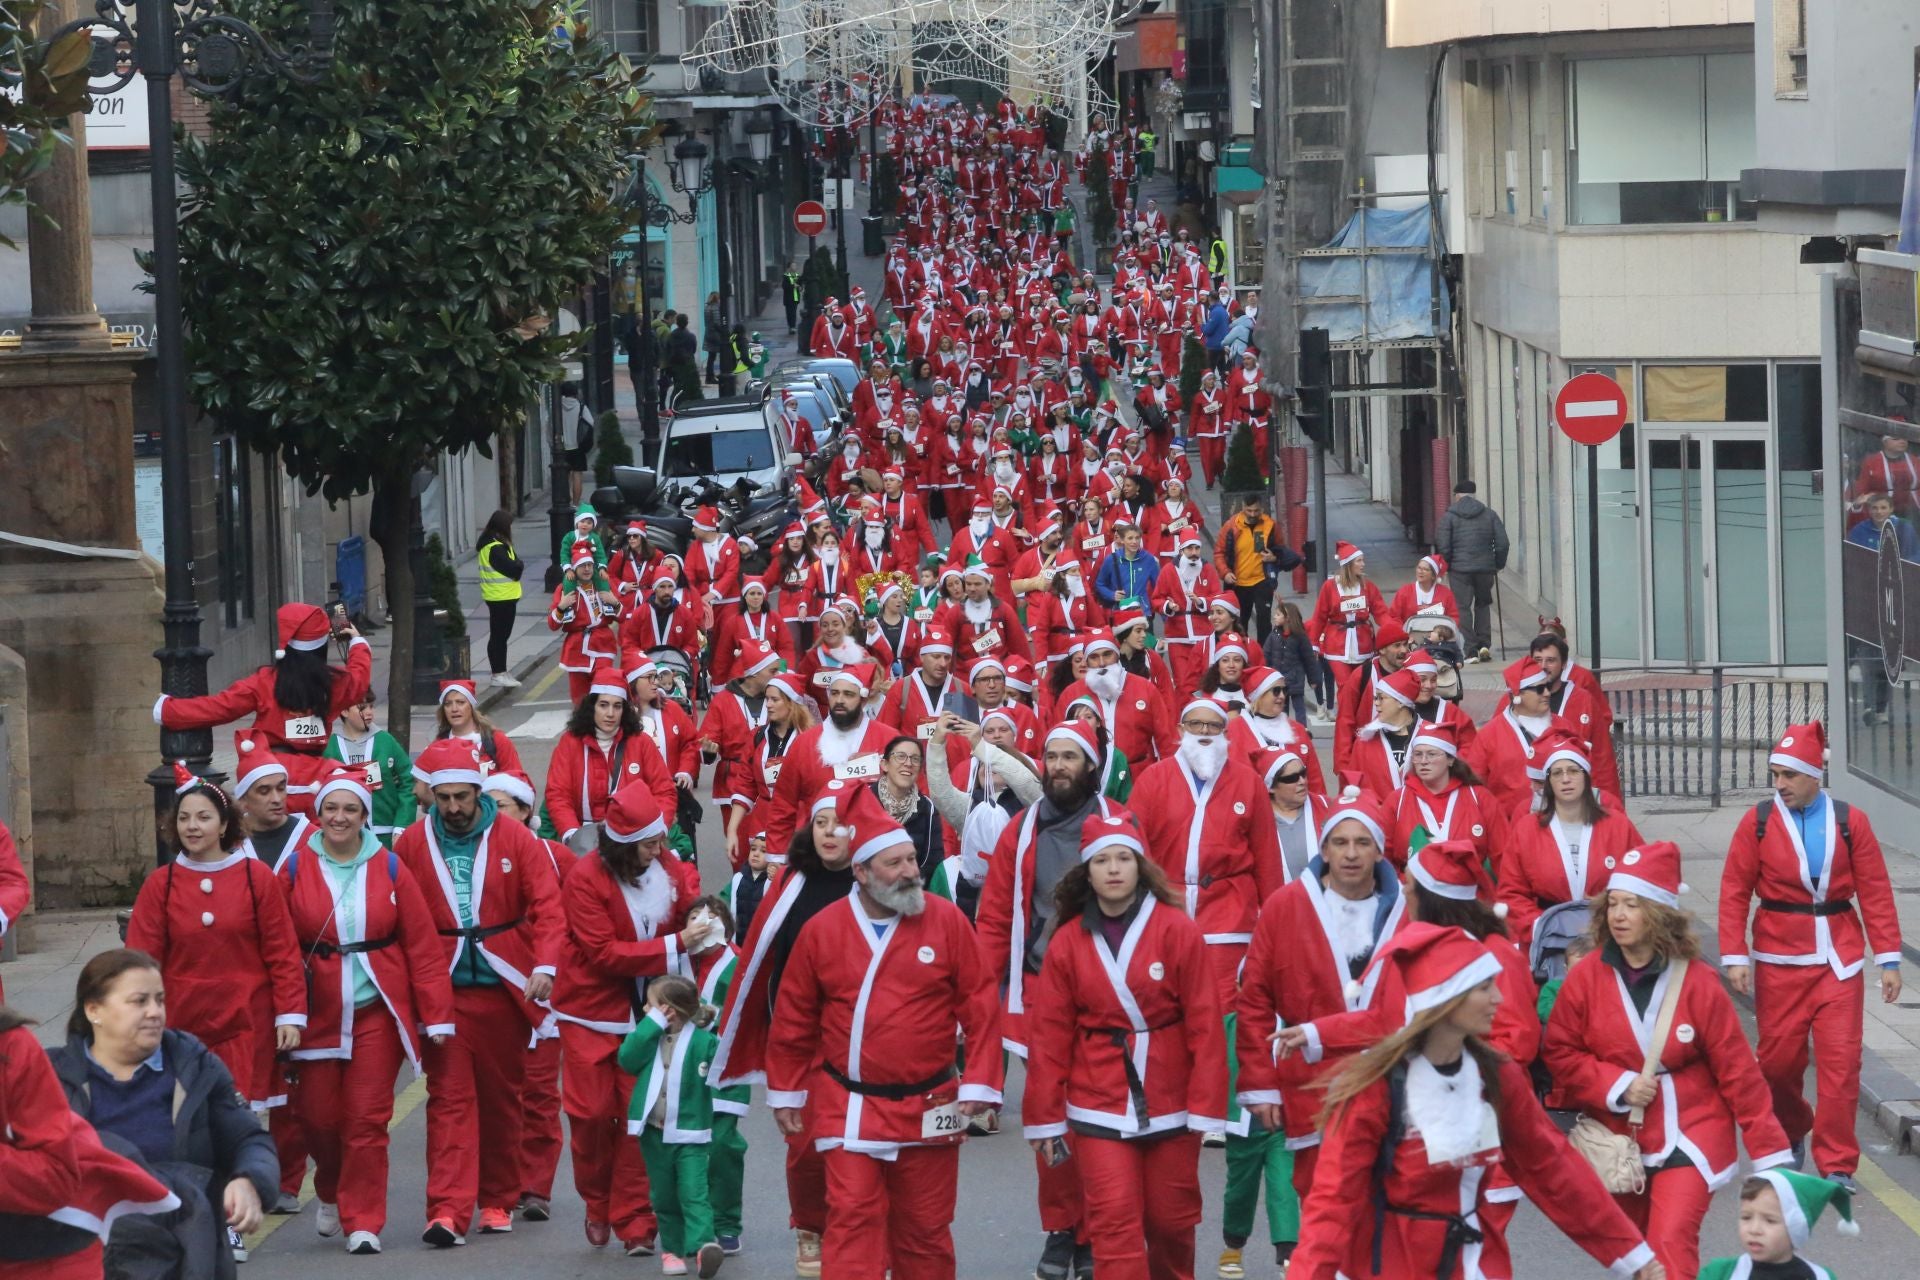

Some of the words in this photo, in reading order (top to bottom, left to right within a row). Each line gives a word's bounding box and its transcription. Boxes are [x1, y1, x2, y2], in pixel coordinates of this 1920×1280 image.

[980, 638, 993, 648] 635
[296, 724, 319, 735] 2280
[846, 766, 867, 775] 945
